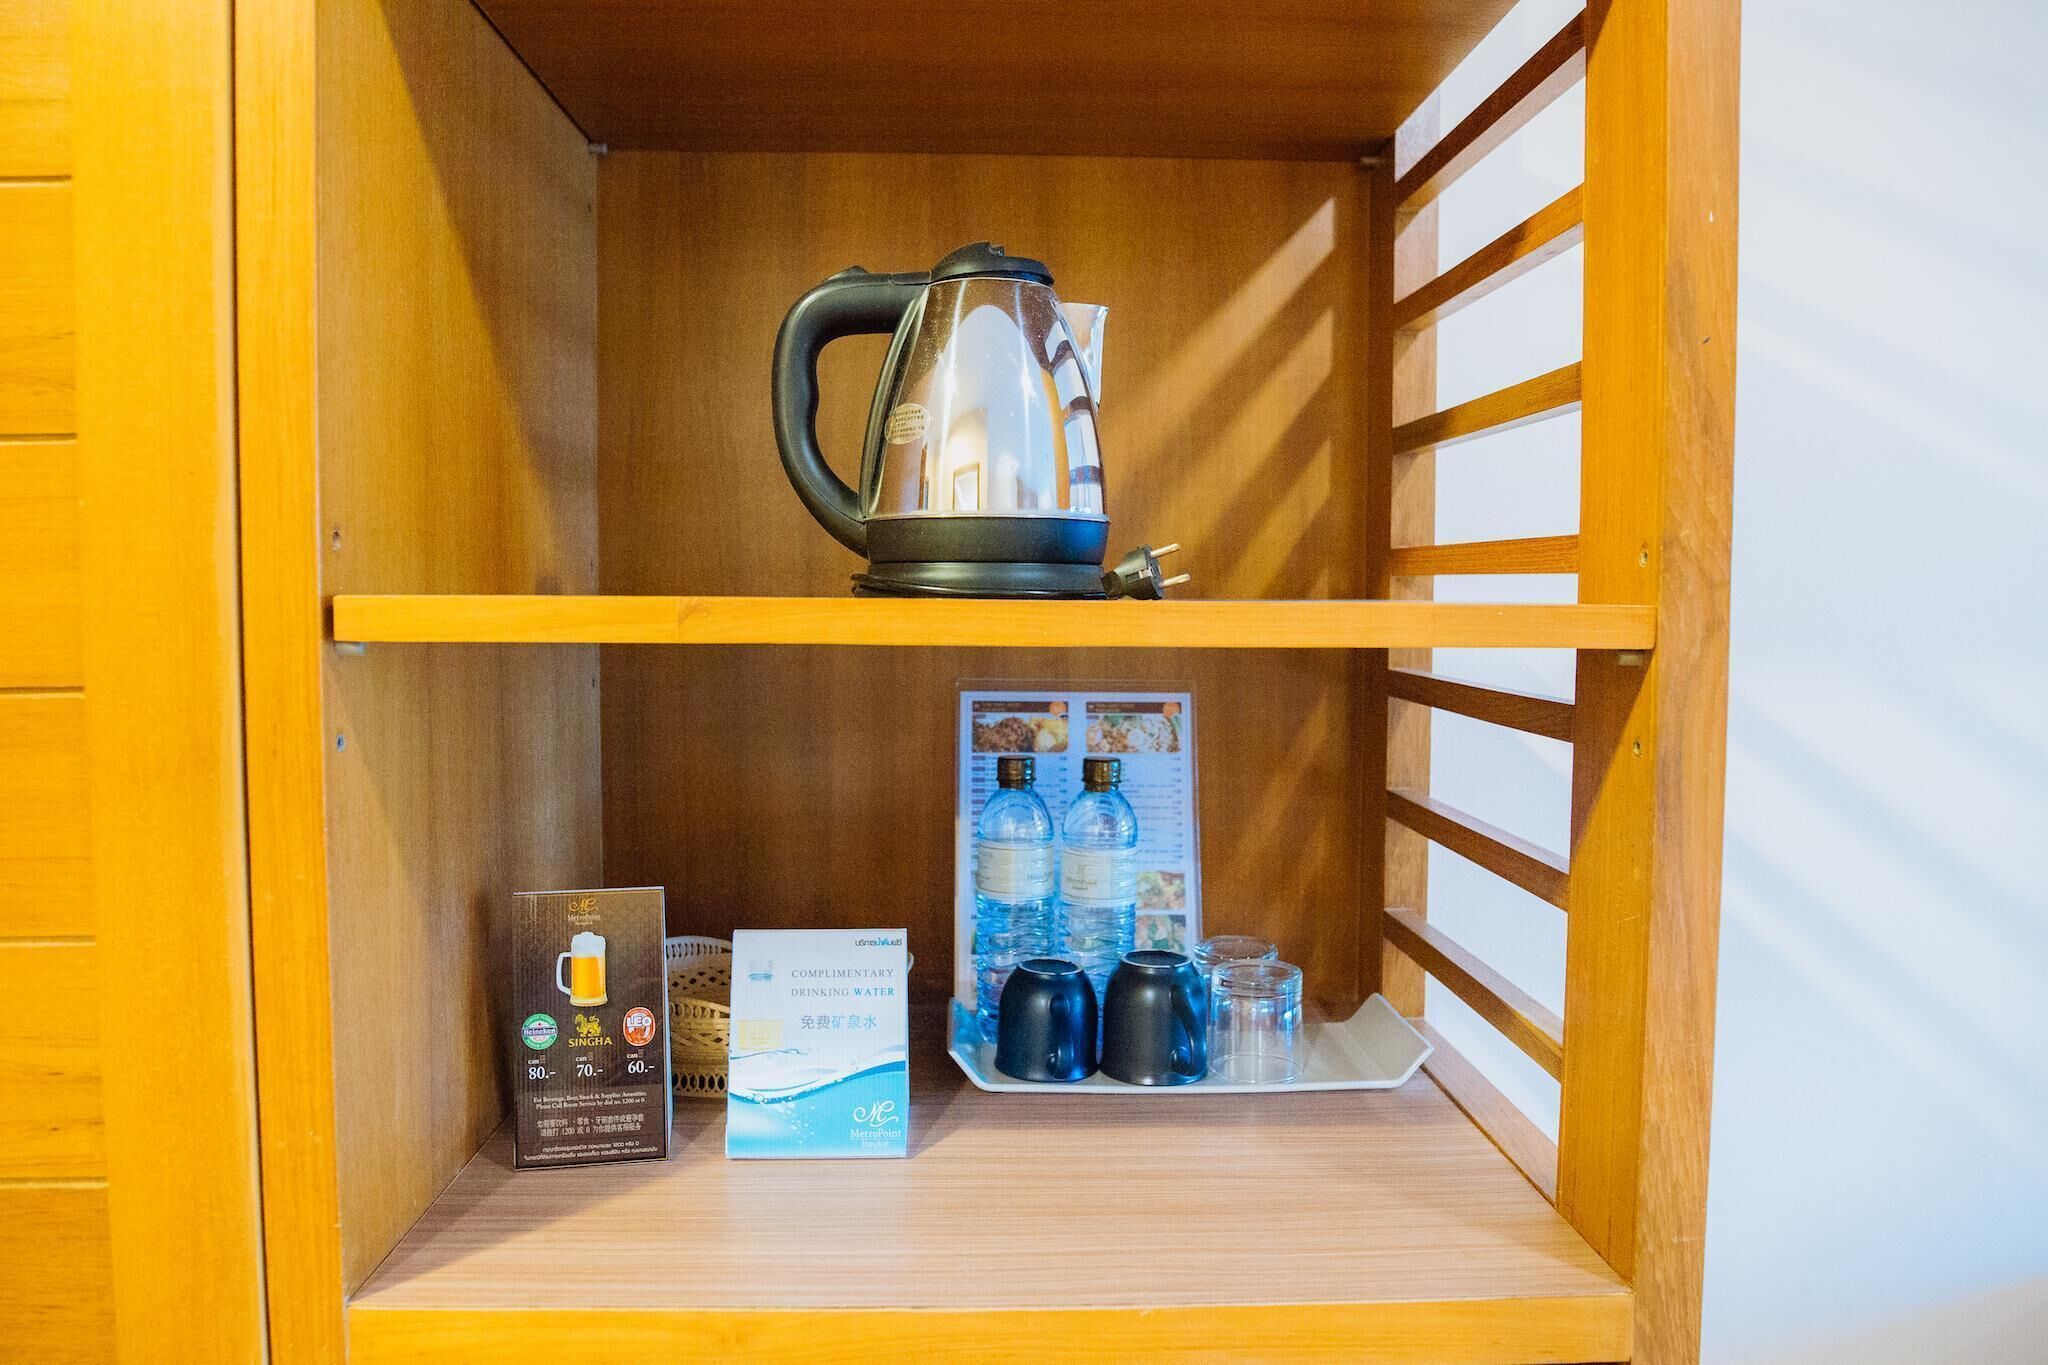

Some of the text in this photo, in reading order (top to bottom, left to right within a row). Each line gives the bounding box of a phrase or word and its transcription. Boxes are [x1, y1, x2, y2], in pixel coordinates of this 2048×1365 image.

[791, 968, 894, 978] COMPLIMENTARY
[791, 987, 895, 997] DRINKING WATER
[626, 1016, 652, 1028] LEO
[801, 1014, 877, 1030] 免费矿泉水
[523, 1028, 556, 1036] Heineken
[568, 1036, 613, 1048] SINGHA
[850, 1128, 901, 1138] MetroPoint
